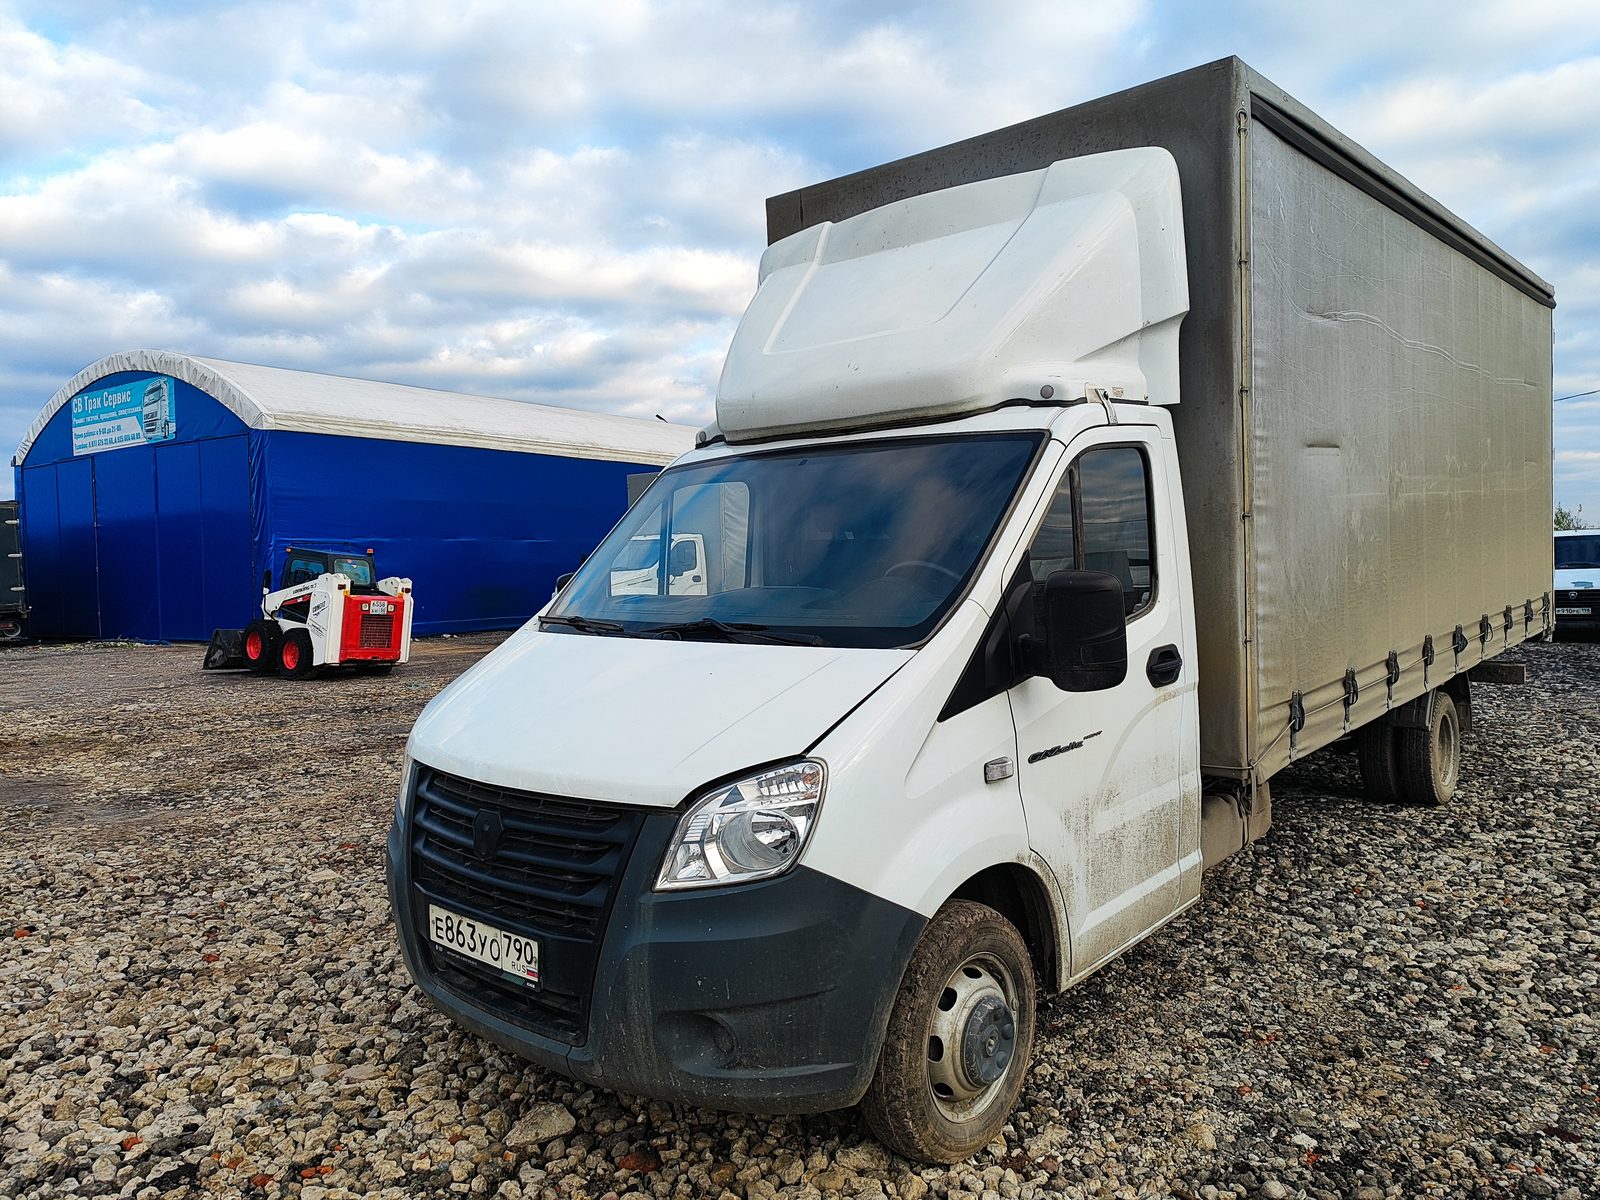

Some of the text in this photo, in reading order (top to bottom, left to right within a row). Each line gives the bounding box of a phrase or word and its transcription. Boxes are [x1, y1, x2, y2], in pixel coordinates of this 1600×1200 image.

[73, 390, 131, 413] СВ Трак Сервис
[435, 915, 533, 965] Е863УО 790
[511, 961, 527, 974] RUS
